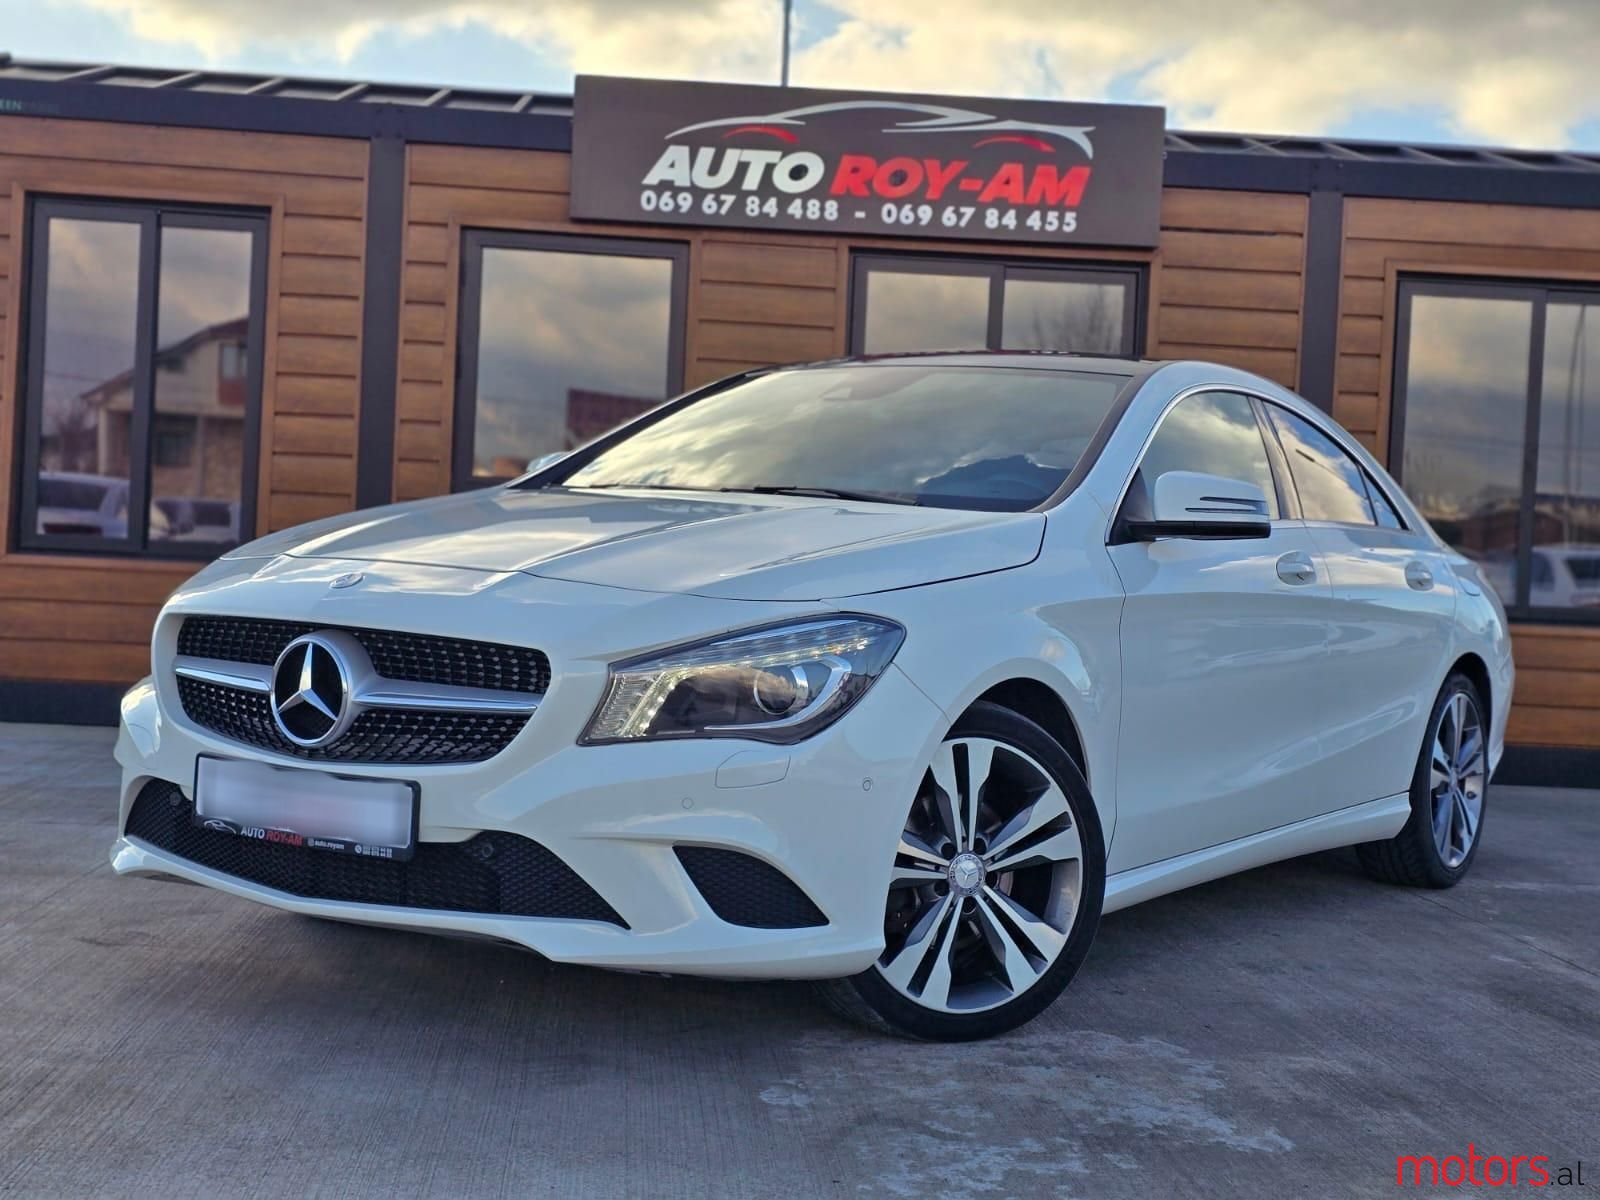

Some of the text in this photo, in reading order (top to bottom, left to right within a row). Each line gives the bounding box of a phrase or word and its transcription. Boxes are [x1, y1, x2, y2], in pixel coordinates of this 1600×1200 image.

[642, 145, 1091, 207] AUTO ROY-AM
[640, 190, 693, 212] 069
[702, 194, 737, 215] 67
[745, 196, 778, 218] 84
[787, 198, 839, 220] 488
[881, 203, 933, 226] 069
[941, 206, 976, 227] 67
[984, 208, 1017, 230] 84
[1026, 210, 1078, 232] 455
[240, 826, 303, 846] AUTO ROY-AM
